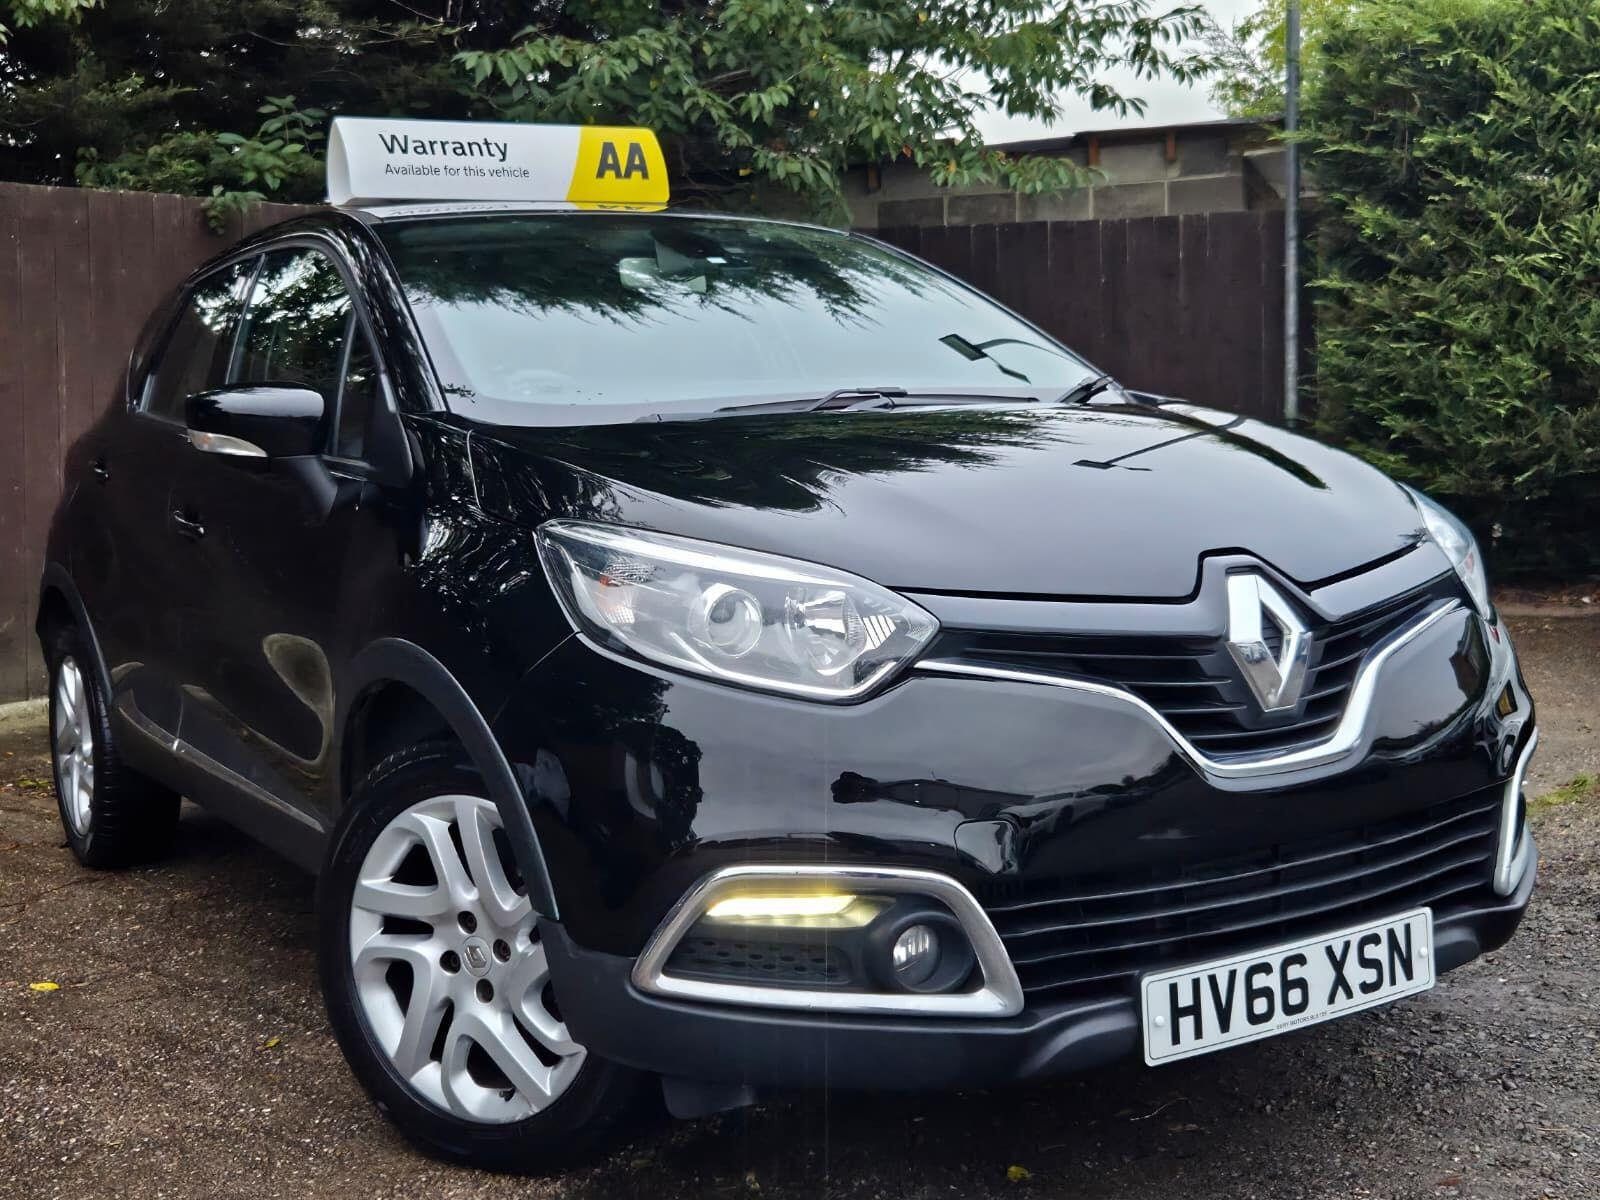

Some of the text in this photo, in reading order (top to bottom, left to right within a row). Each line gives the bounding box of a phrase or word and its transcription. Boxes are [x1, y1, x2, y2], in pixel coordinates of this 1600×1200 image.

[378, 133, 508, 162] Warranty
[595, 142, 649, 180] AA
[385, 163, 530, 179] Available for this vehicle
[1169, 923, 1415, 1047] HV66 XSN
